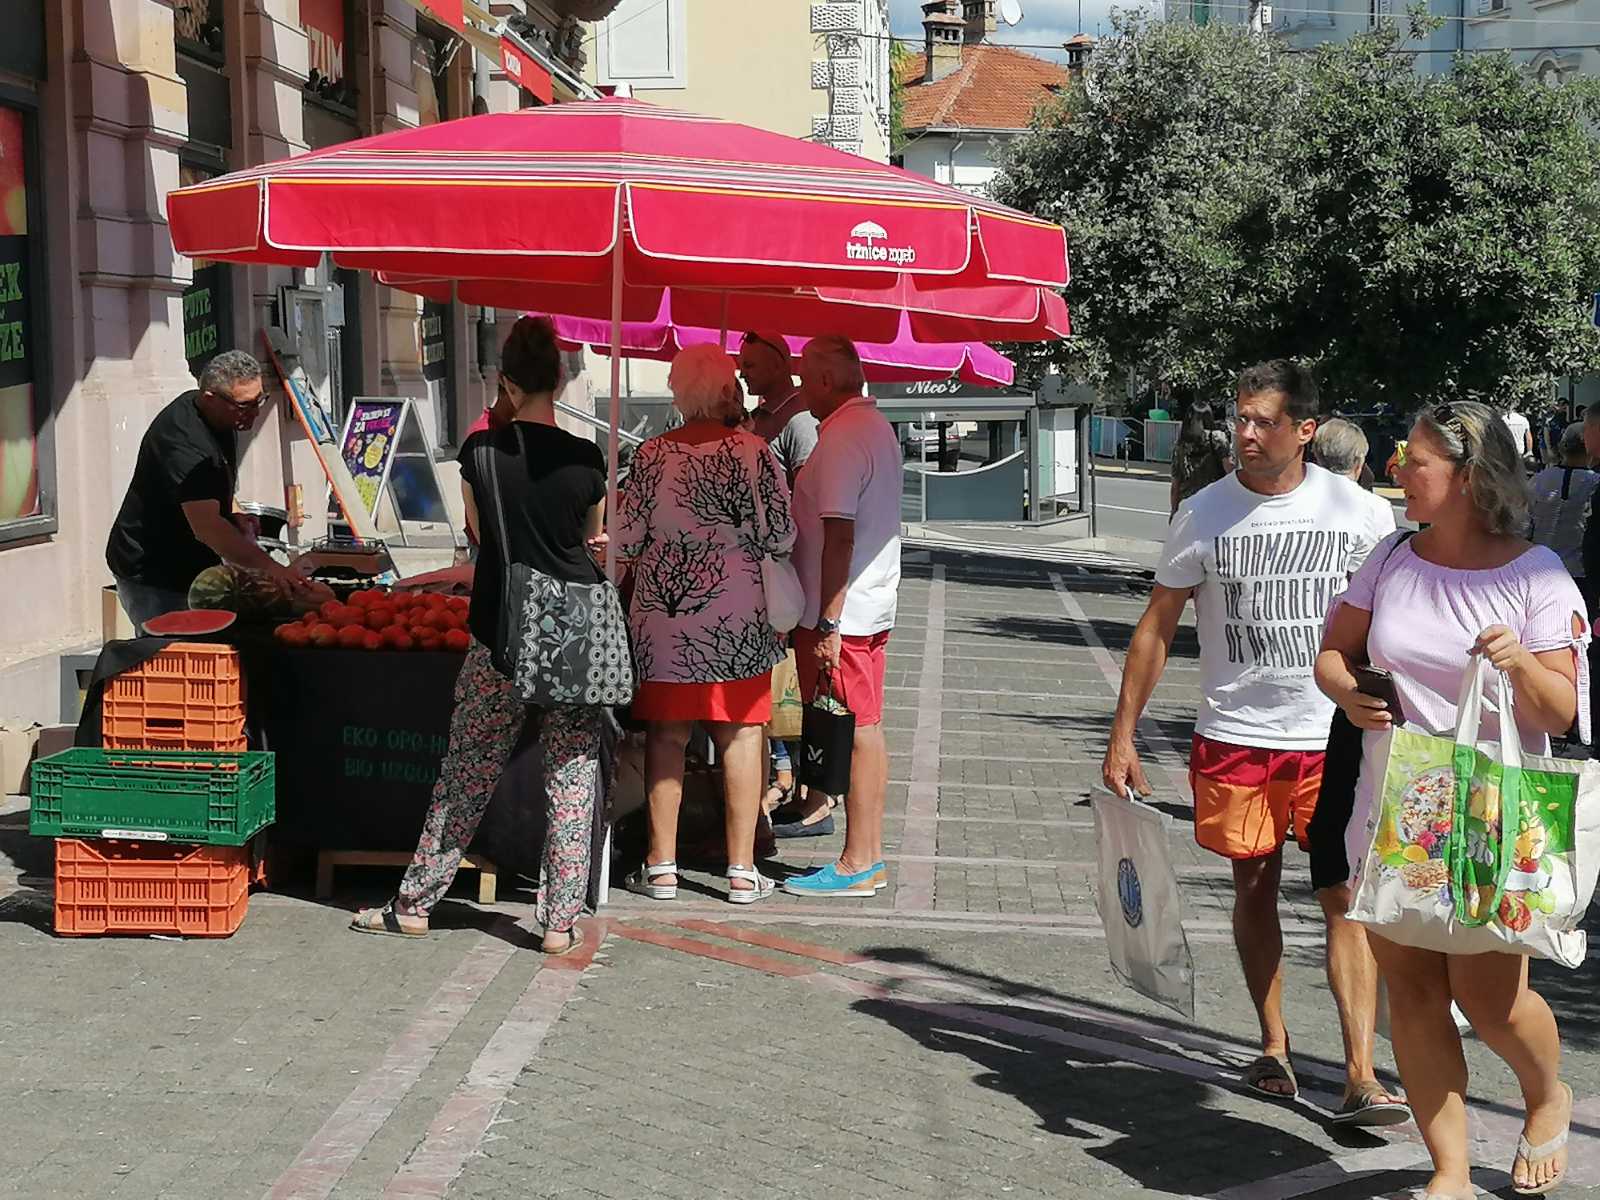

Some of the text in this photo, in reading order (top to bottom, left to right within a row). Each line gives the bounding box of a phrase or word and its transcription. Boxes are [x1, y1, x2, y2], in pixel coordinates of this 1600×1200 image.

[905, 380, 963, 395] Nico's
[1214, 530, 1335, 579] INFORMATION
[1220, 581, 1243, 620] THE
[1225, 623, 1323, 669] OF DEMOCR
[343, 726, 378, 747] EKO
